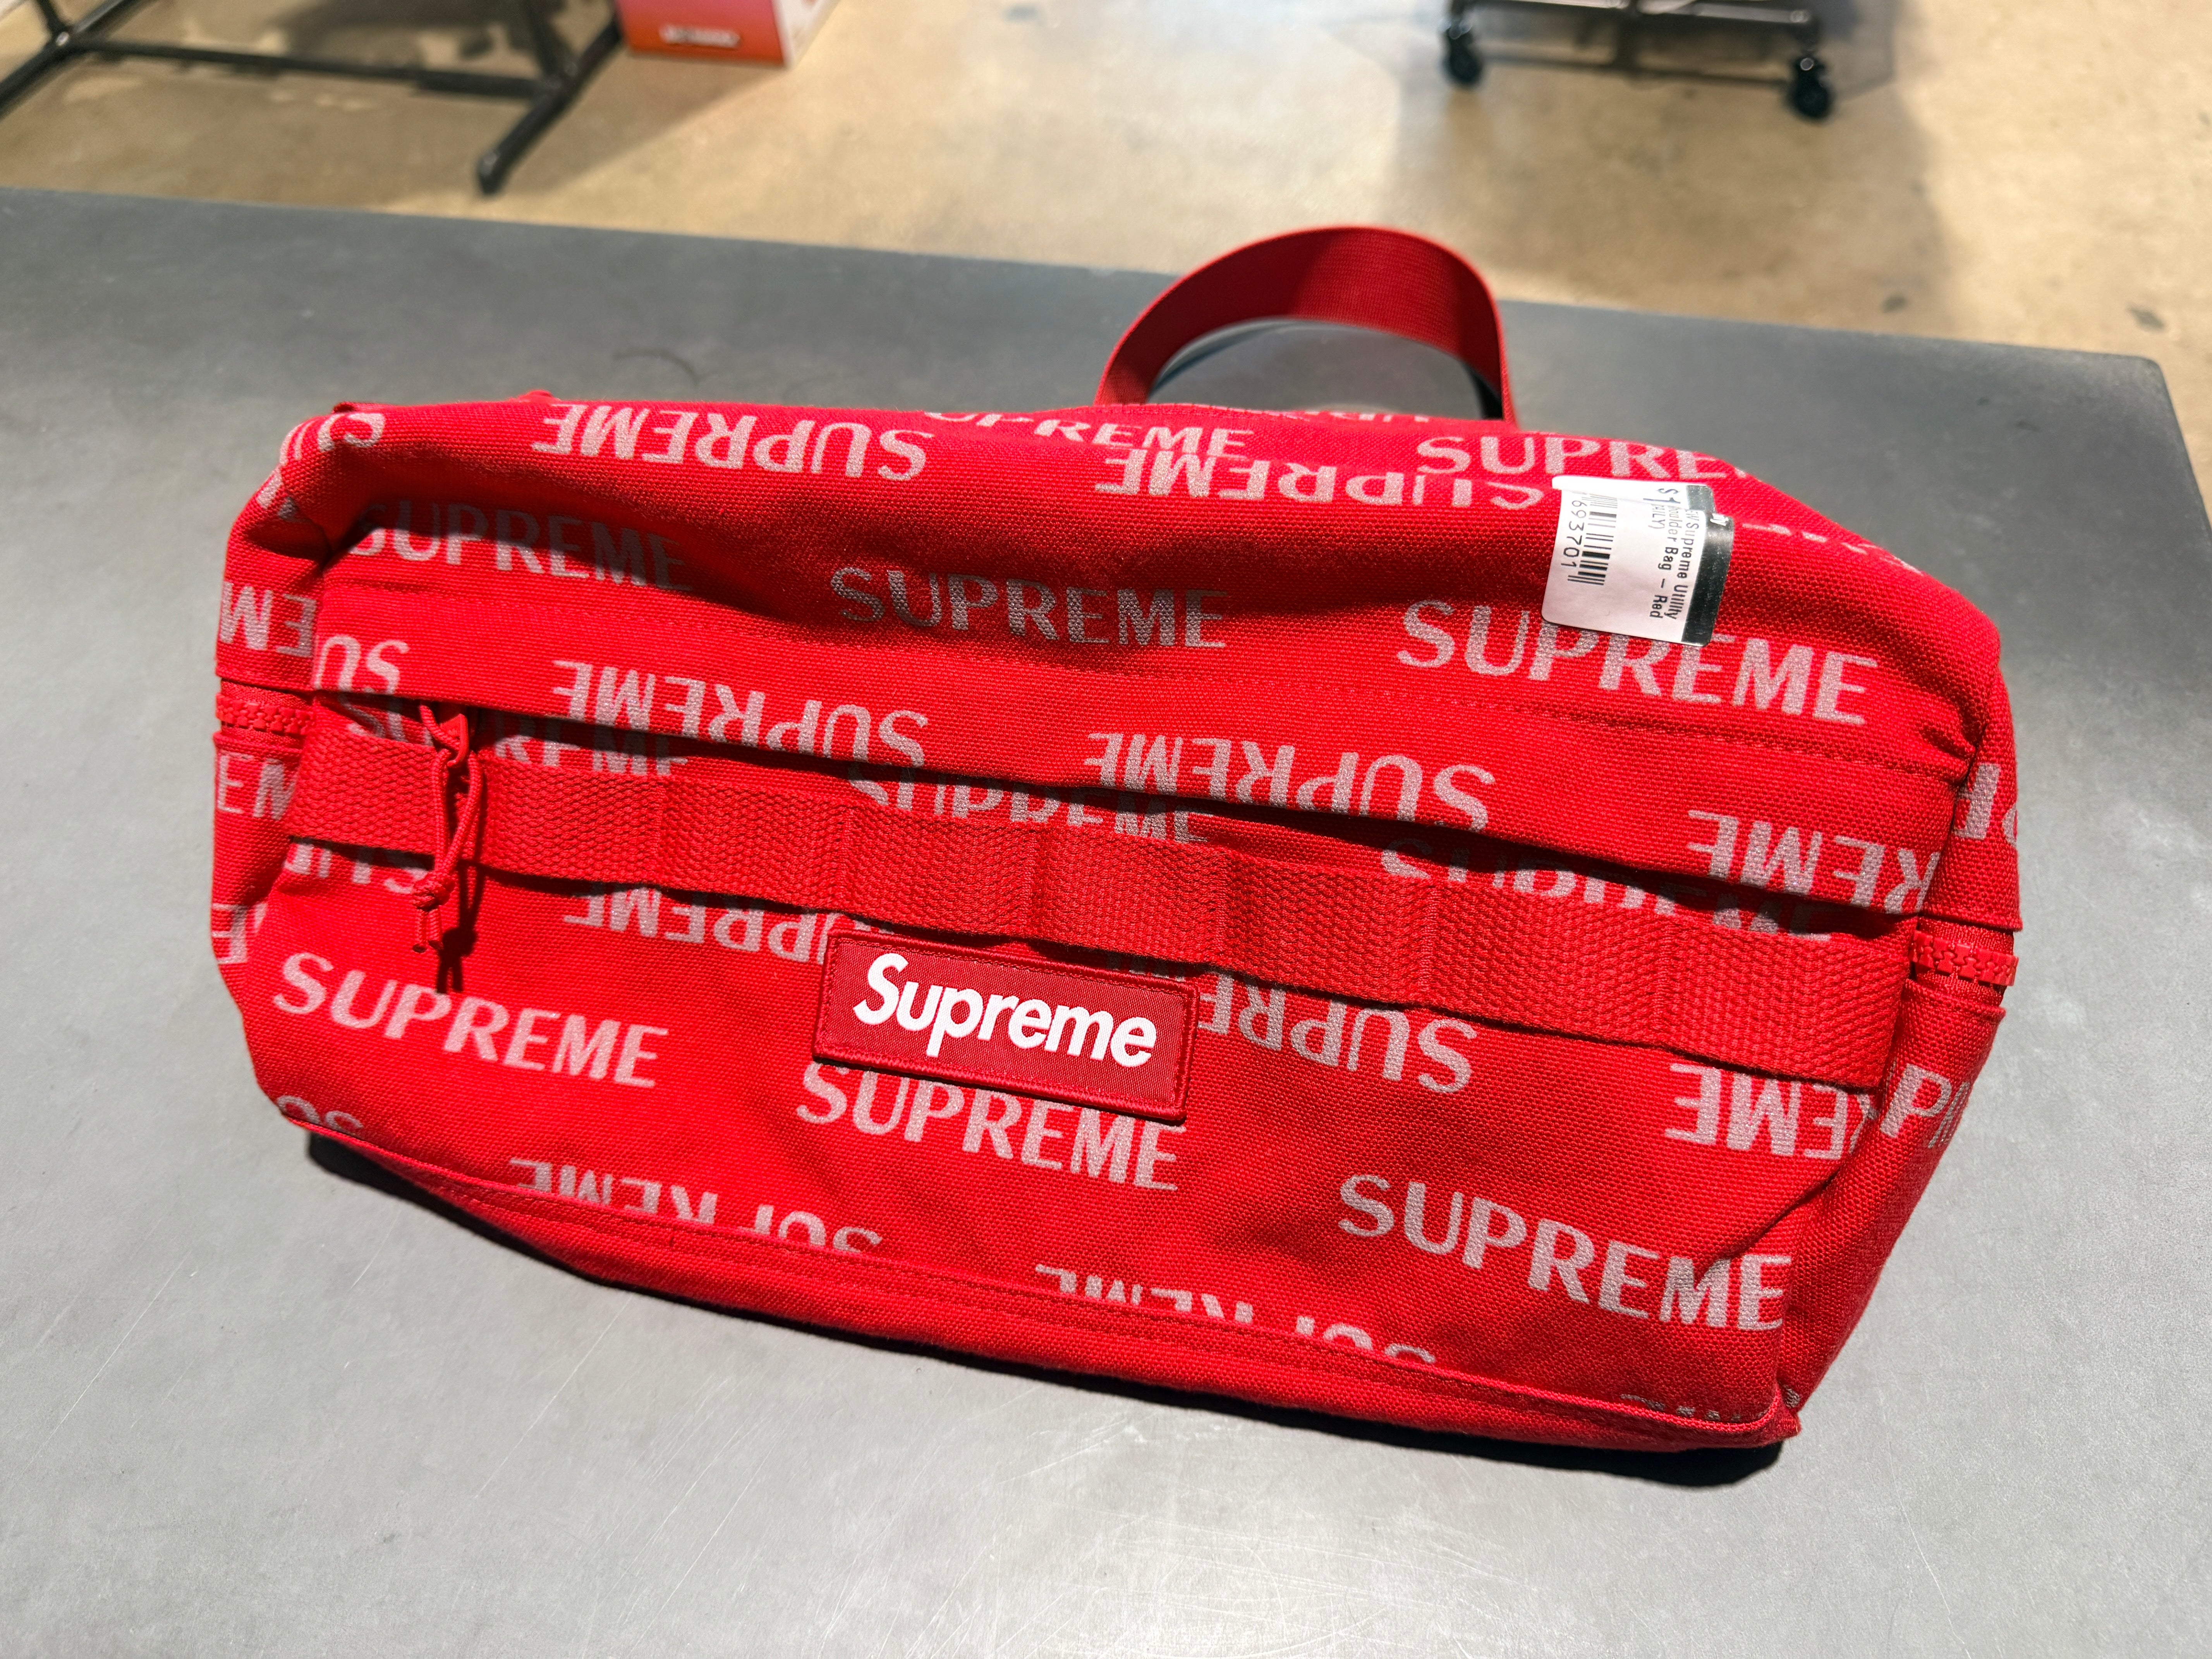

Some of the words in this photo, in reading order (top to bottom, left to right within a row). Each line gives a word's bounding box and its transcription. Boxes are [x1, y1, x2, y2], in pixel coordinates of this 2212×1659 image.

[531, 404, 935, 481] SUPREME
[347, 500, 693, 591] SUPREME
[1561, 500, 1588, 568] 693701
[1658, 547, 1679, 570] Bag
[1677, 522, 1699, 579] Supreme
[830, 567, 1228, 648] SUPREME
[1649, 594, 1668, 619] Red
[1665, 585, 1688, 620] Utility
[1397, 599, 1877, 725] SUPREME
[552, 659, 928, 768] SUPREME
[1084, 732, 1496, 833] SUPREME
[273, 952, 668, 1087] SUPREME
[853, 953, 1157, 1068] Supreme
[796, 1061, 1187, 1191] SUPREME
[1338, 1174, 1792, 1331] SUPREME
